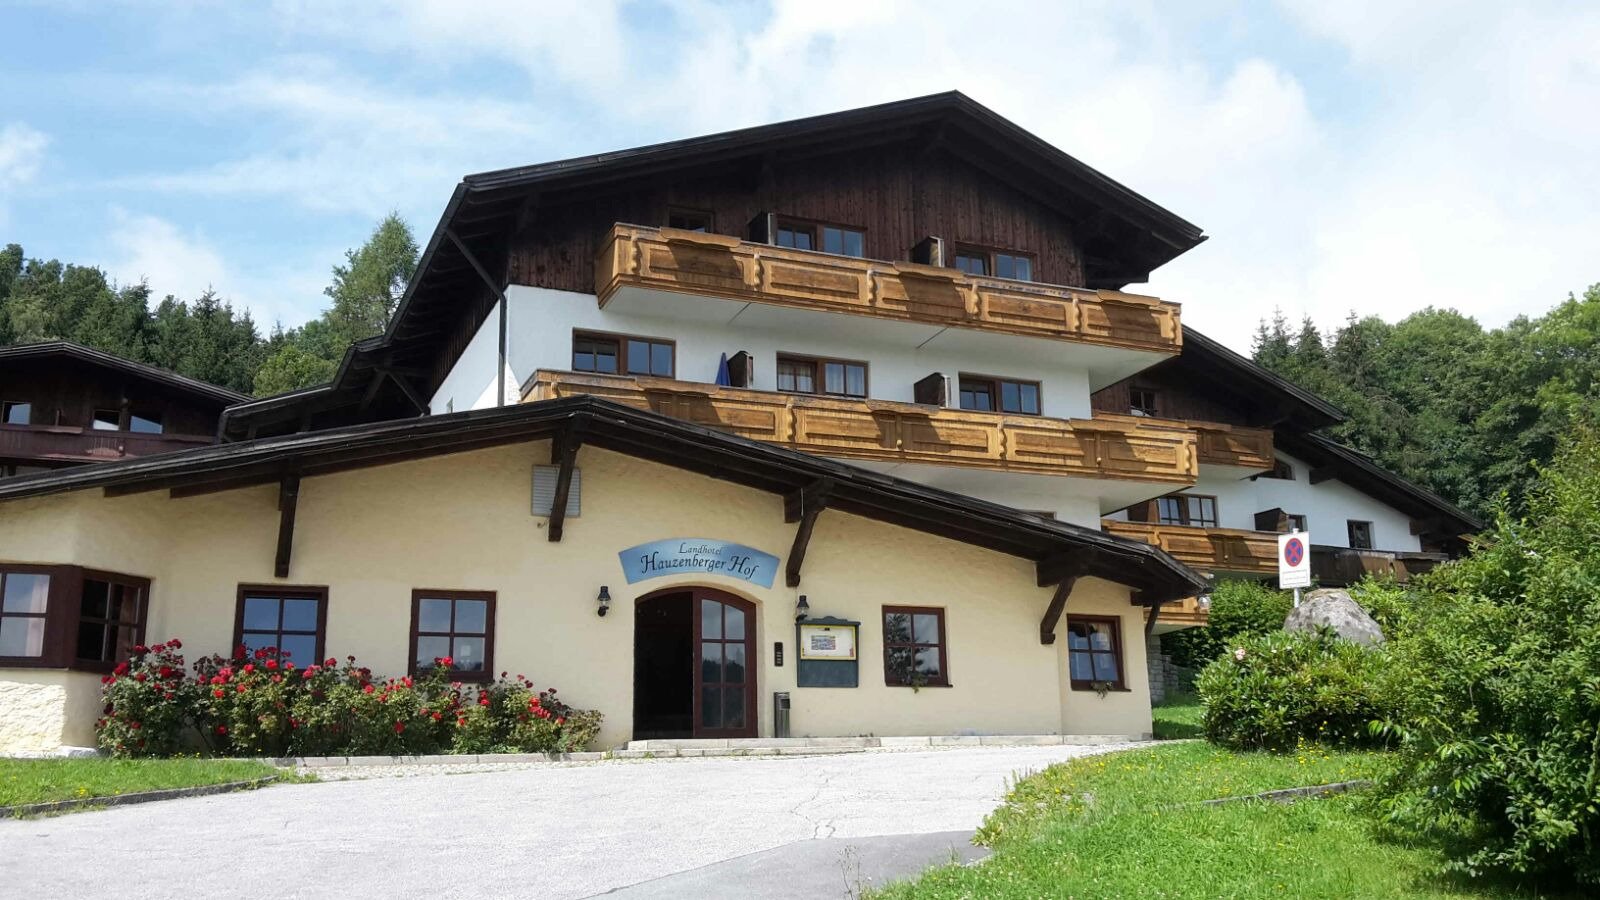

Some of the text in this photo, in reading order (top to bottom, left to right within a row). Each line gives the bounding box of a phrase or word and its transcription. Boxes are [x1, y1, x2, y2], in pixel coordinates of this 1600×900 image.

[678, 542, 723, 555] Landhotel
[640, 551, 760, 580] Hauzenberger Hof
